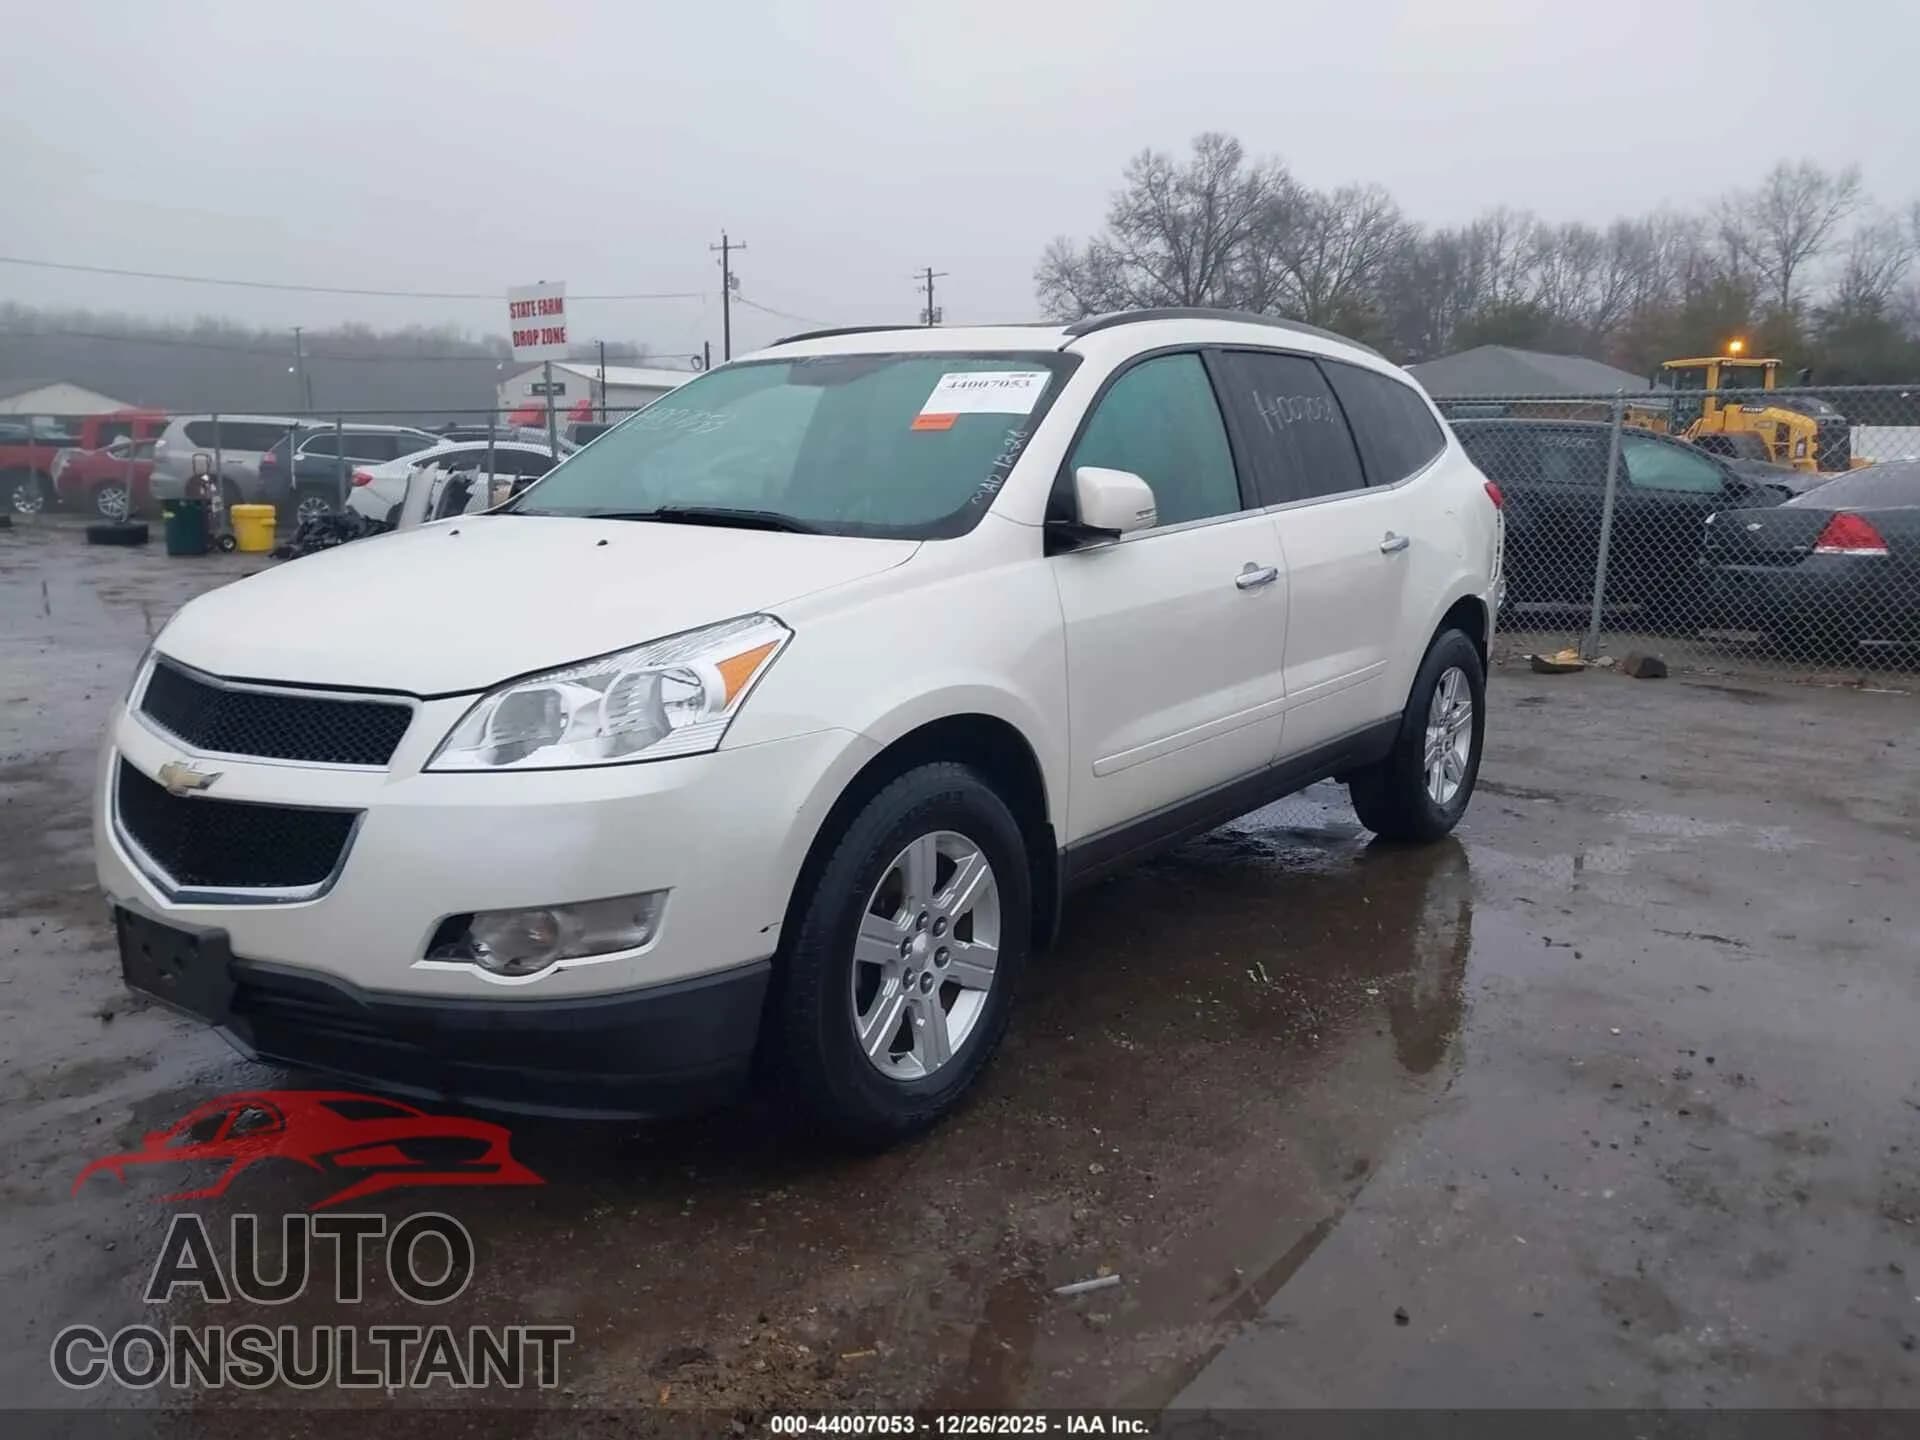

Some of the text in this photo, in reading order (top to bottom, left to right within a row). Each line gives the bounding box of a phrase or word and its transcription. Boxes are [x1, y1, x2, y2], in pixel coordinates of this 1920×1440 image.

[510, 297, 563, 319] STATE FARM
[513, 327, 566, 347] DROP ZONE
